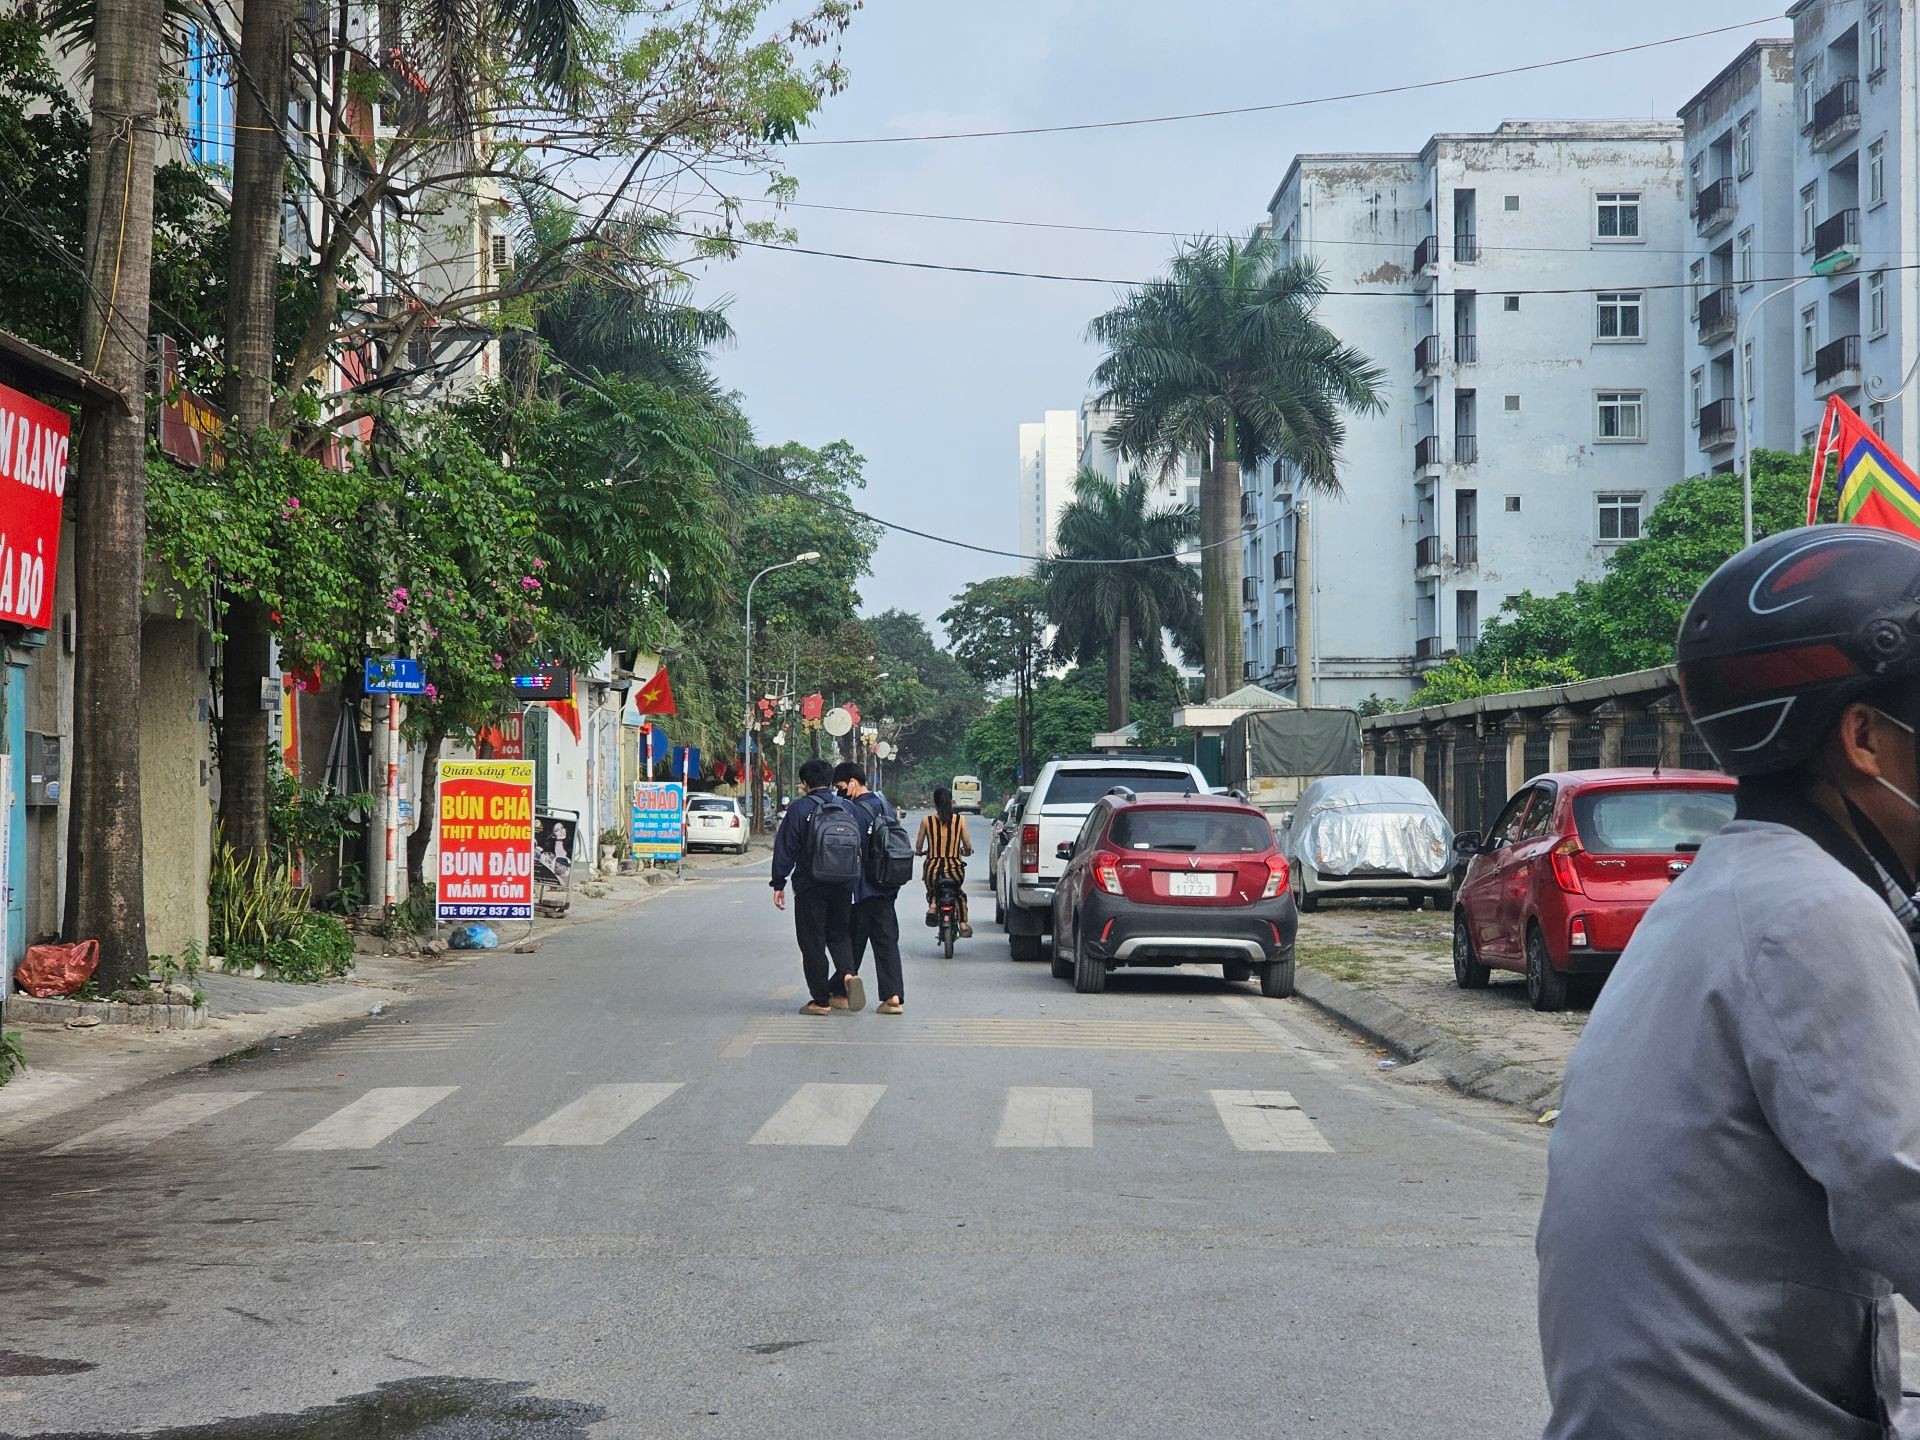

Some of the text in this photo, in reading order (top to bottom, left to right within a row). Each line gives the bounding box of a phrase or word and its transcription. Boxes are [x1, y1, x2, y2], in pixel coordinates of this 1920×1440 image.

[13, 416, 69, 498] RANG
[16, 537, 44, 619] BÒ
[401, 663, 406, 676] 1
[441, 765, 532, 779] Quán Sáng Béo
[441, 790, 484, 820] BÚN
[490, 788, 531, 820] CHẢ
[636, 785, 679, 811] CHÁO
[441, 823, 532, 842] THỊT NƯỚNG
[441, 847, 484, 876] BÚN
[489, 847, 531, 882] ĐẬU
[447, 878, 524, 898] MẮM TÔM
[1183, 874, 1202, 884] 30L
[1175, 885, 1211, 895] 117.23
[440, 906, 530, 916] ĐT: 0972 837 361
